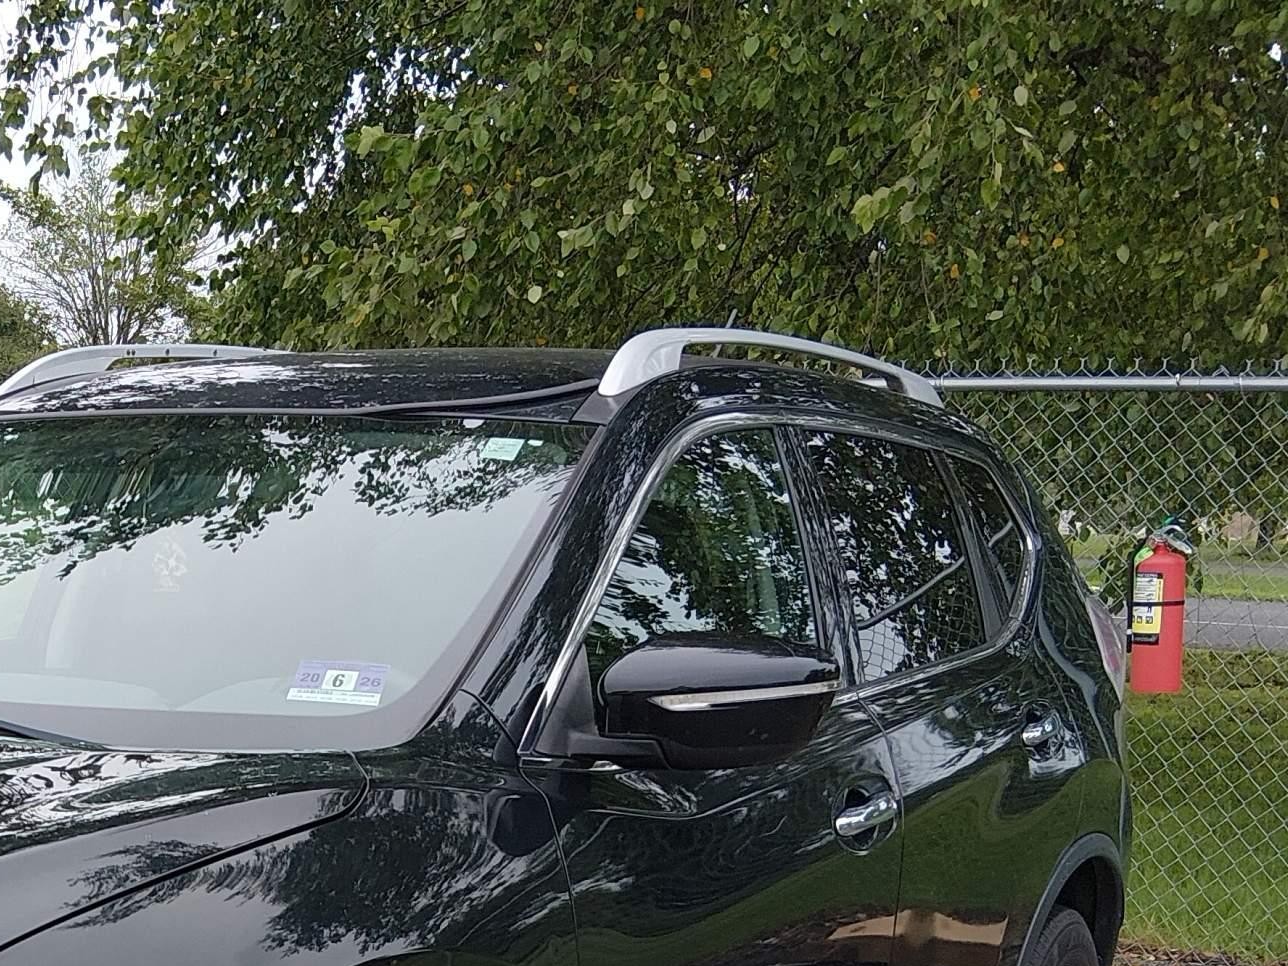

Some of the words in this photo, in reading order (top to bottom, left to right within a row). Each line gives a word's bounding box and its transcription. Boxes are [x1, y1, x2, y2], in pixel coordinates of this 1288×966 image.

[300, 672, 320, 683] 20
[332, 673, 345, 688] 6
[359, 677, 382, 687] 26
